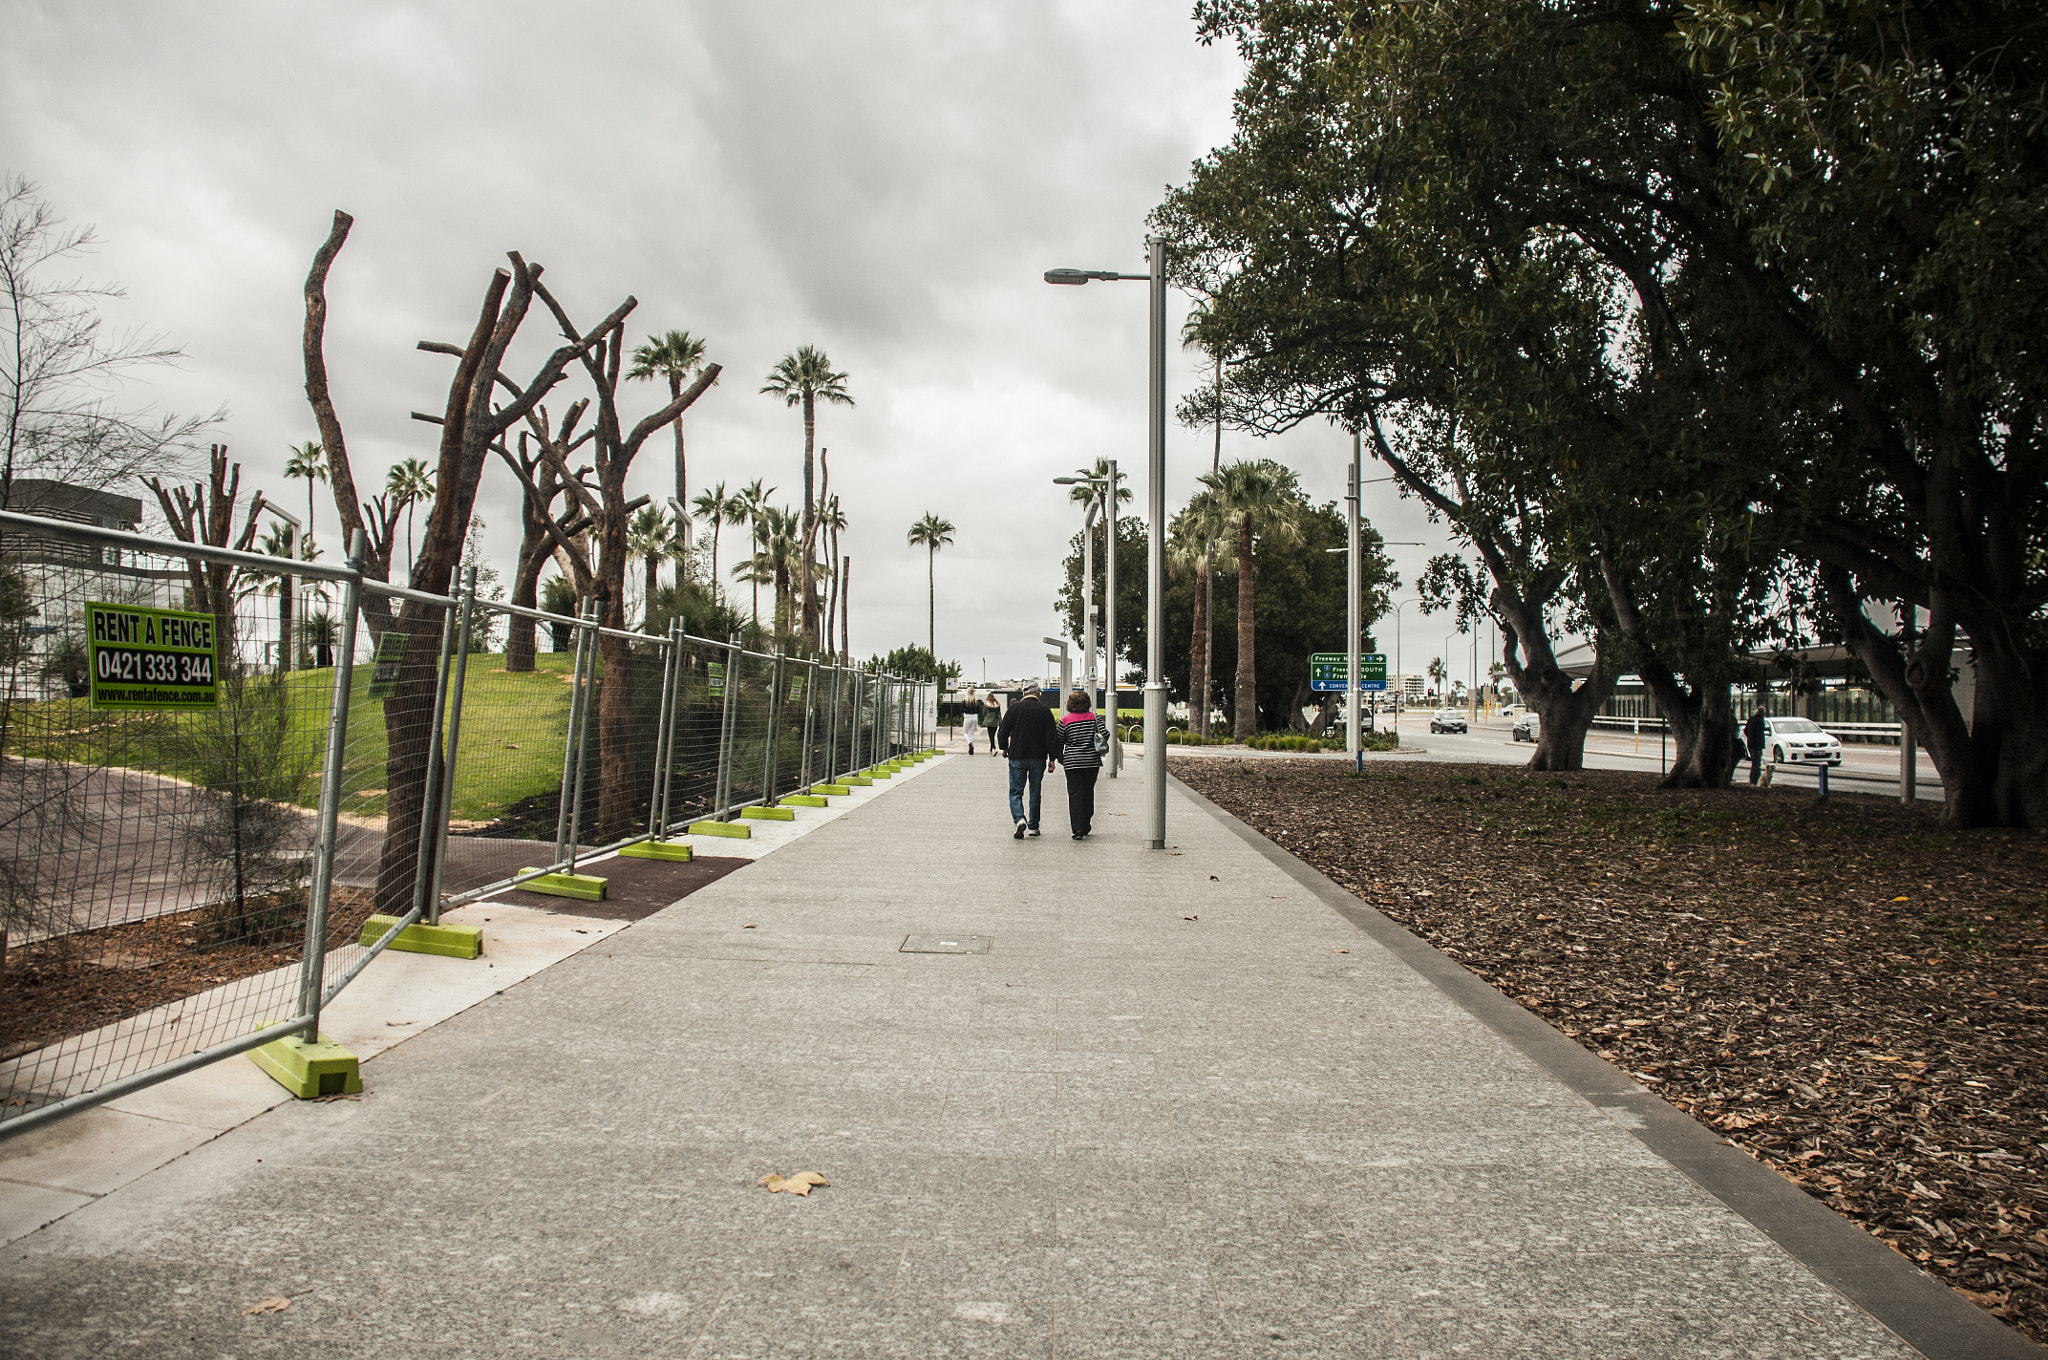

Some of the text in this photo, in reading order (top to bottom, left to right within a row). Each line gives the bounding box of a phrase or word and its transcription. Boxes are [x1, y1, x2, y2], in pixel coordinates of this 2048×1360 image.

[93, 611, 212, 649] RENT A FENCE
[98, 650, 212, 683] 0421 333 344
[98, 687, 215, 702] www.rentafence.com.au
